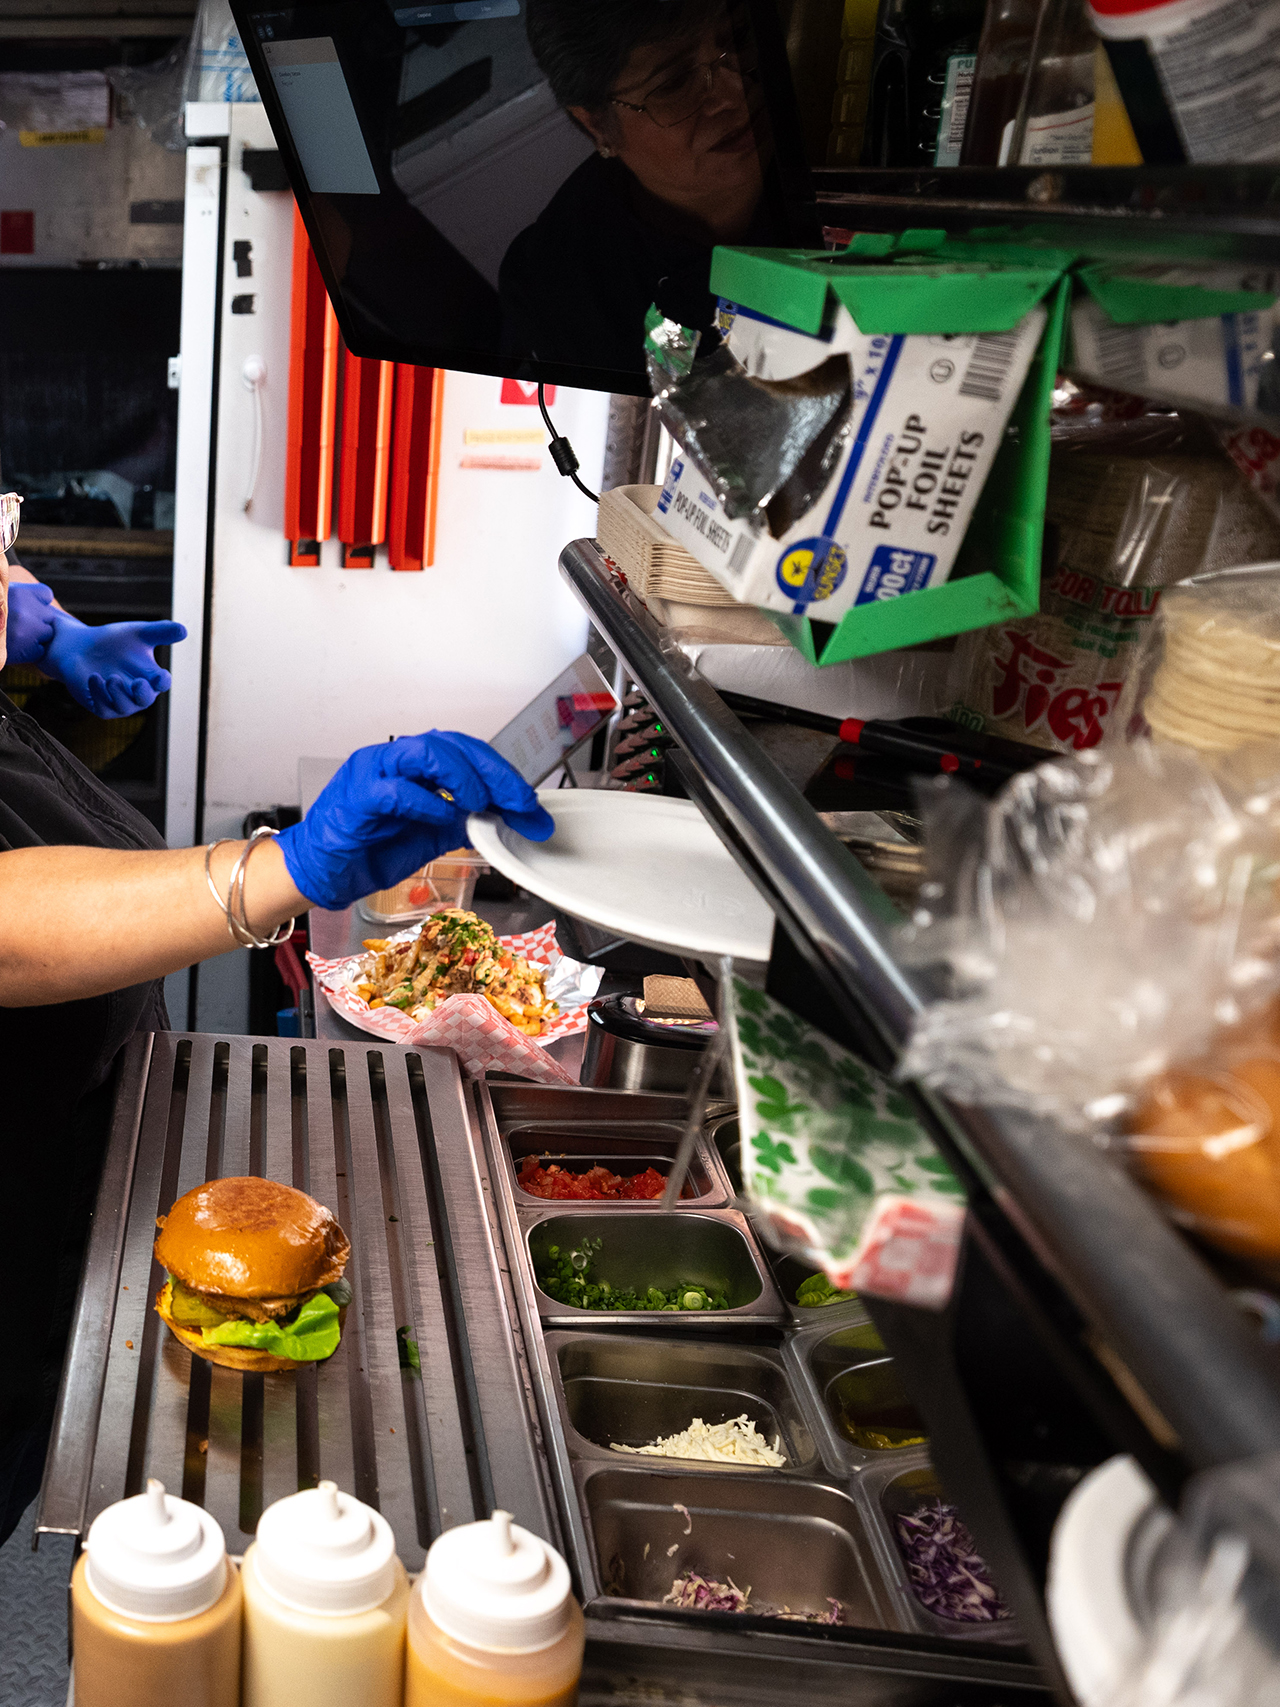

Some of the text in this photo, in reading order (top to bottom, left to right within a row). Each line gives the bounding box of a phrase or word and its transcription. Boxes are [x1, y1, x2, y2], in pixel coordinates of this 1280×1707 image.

[868, 413, 927, 530] POP-UP
[905, 446, 950, 511] FOIL
[926, 430, 985, 537] SHEETS
[673, 490, 698, 523] POP-UP
[692, 508, 710, 535] FOIL
[706, 519, 733, 554] SHEETS
[814, 544, 847, 600] SUNSET
[875, 551, 915, 601] 00ct
[993, 630, 1123, 750] Fies
